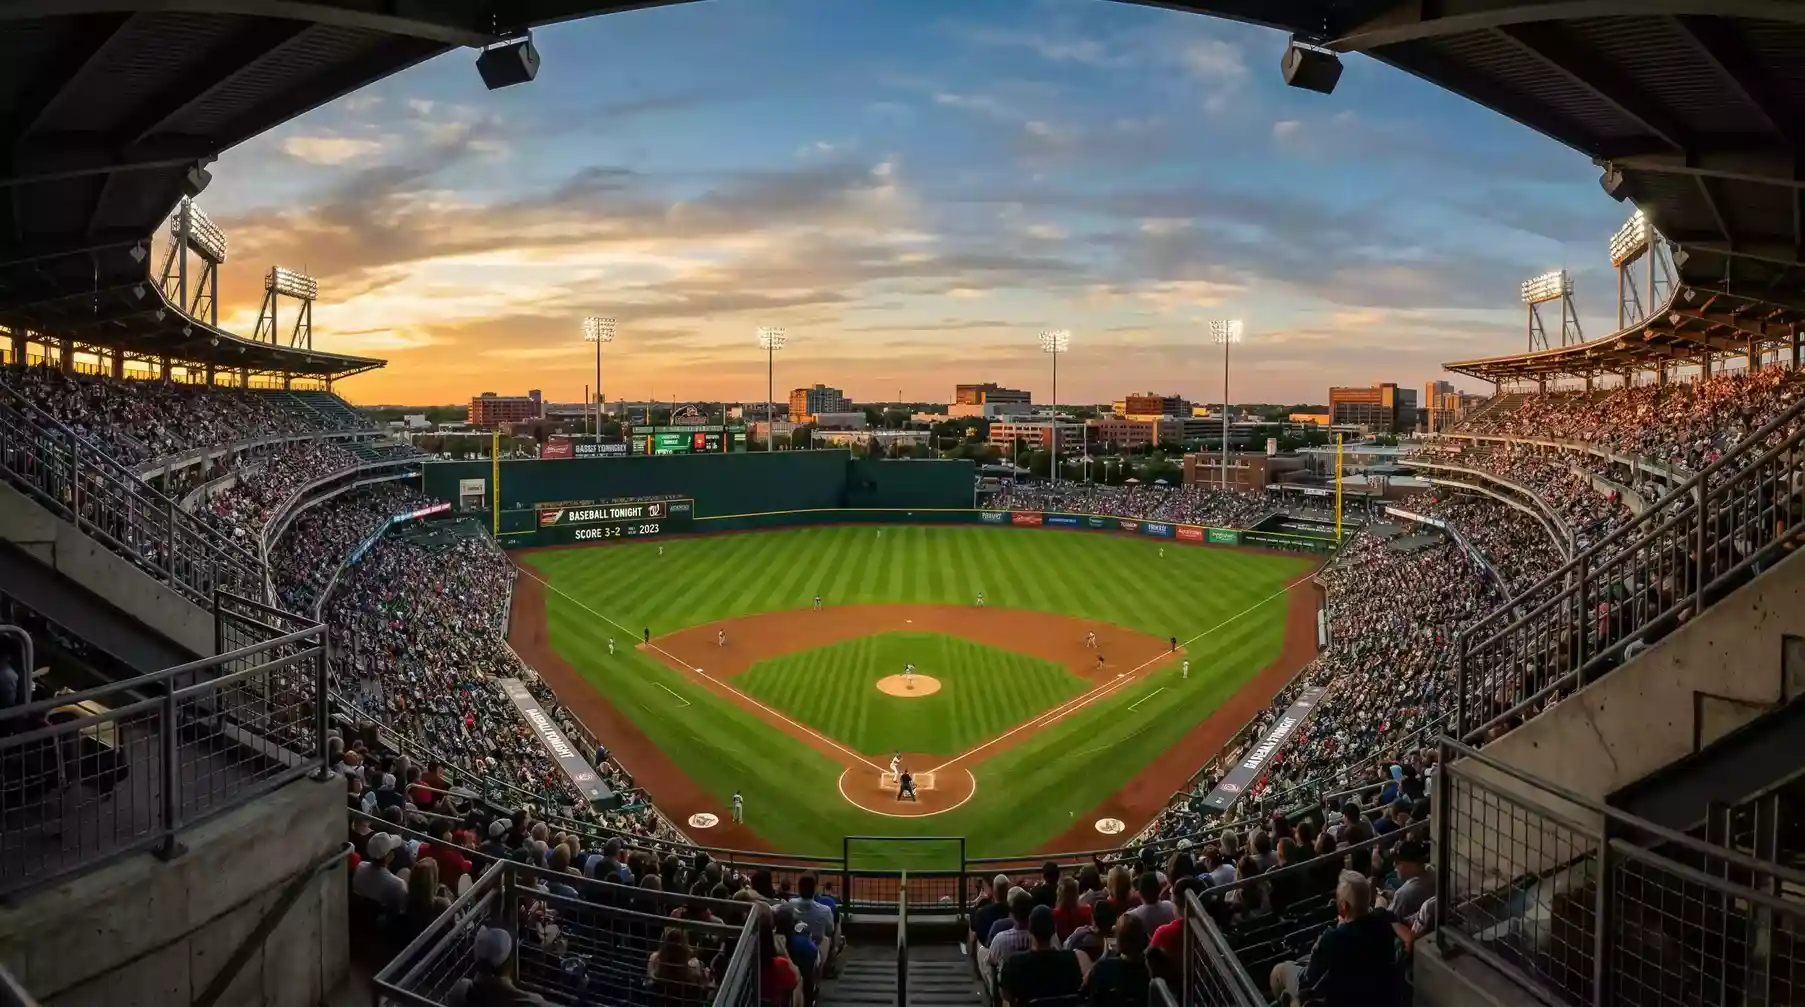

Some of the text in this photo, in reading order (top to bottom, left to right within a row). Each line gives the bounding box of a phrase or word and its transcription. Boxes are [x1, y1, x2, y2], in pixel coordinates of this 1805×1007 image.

[569, 507, 643, 521] BASEBALL TONIGHT
[575, 528, 602, 540] SCORE
[604, 526, 621, 537] 3-2
[639, 523, 660, 534] 2023
